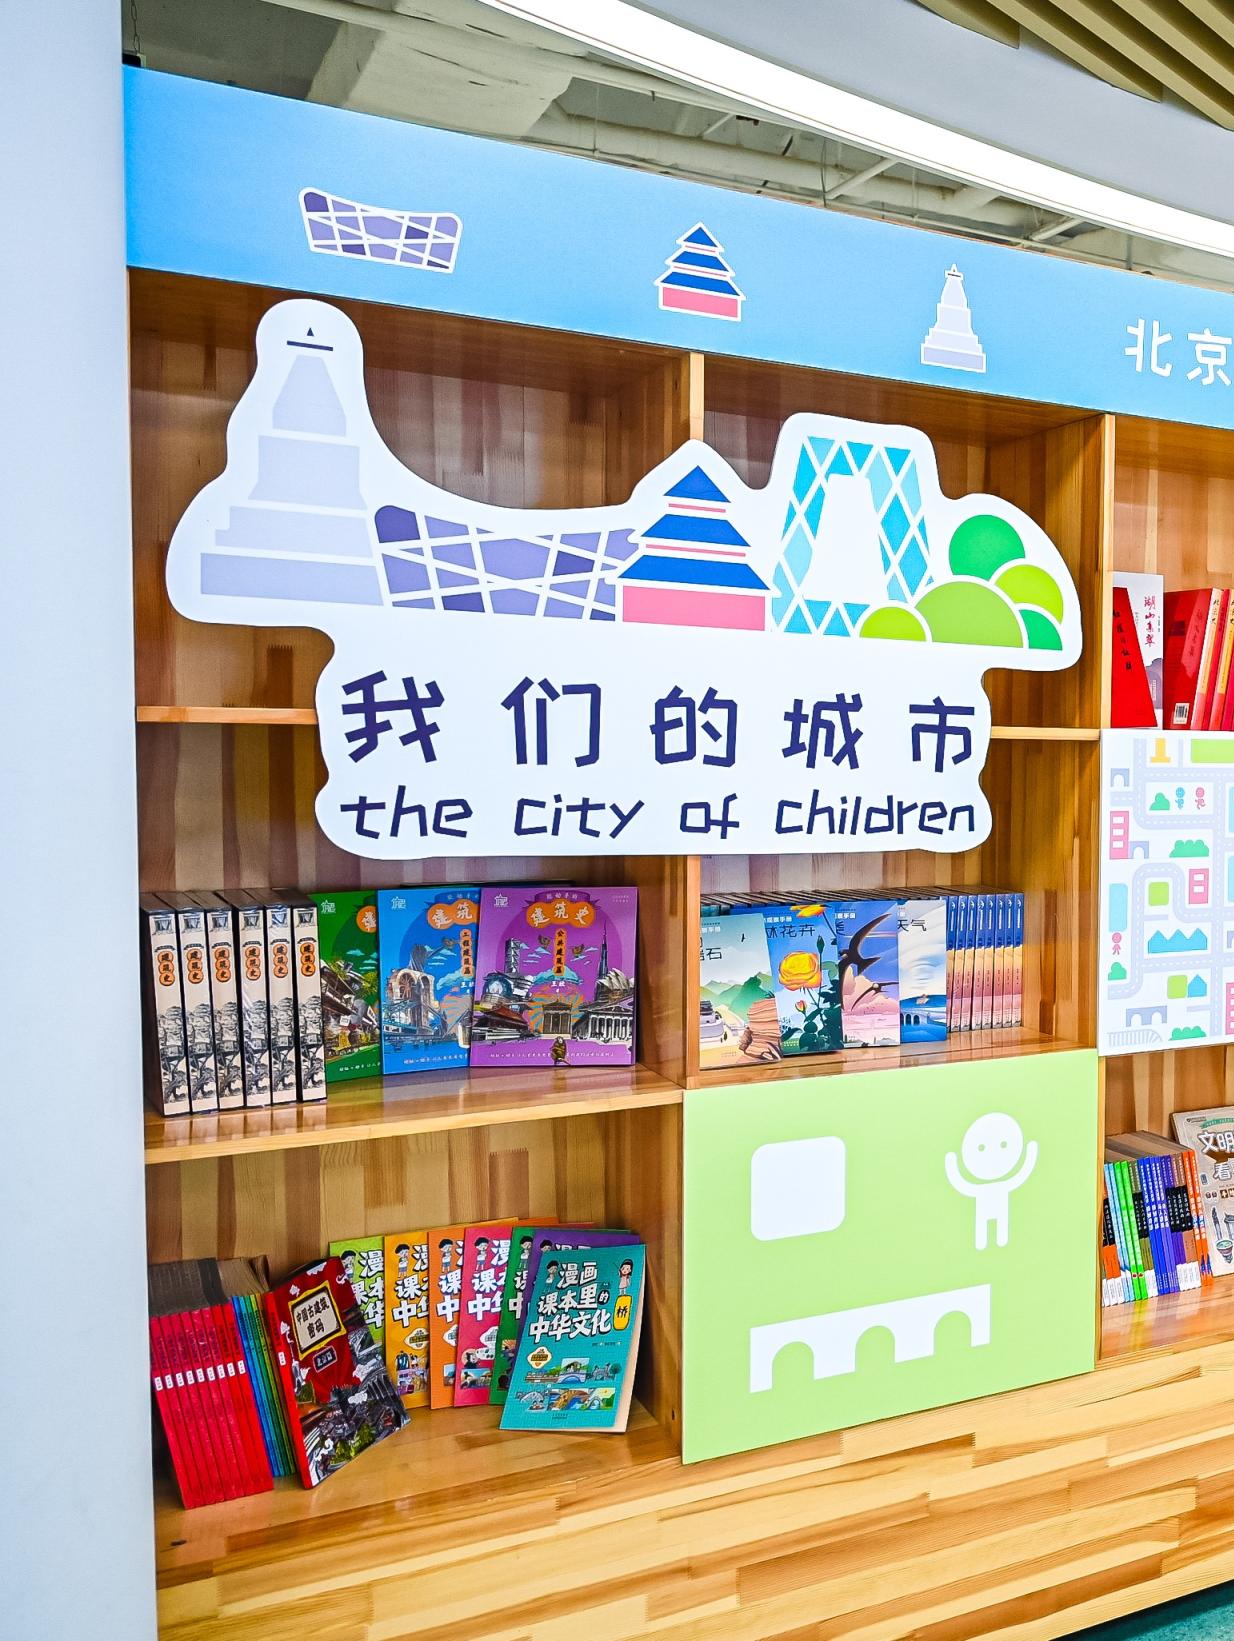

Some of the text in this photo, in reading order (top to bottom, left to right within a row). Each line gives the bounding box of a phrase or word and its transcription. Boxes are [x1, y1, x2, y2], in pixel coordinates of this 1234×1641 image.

[341, 670, 976, 774] 我们的城市
[340, 785, 976, 840] the city of children
[897, 919, 927, 932] 天气
[556, 1260, 598, 1290] 漫画
[295, 1296, 330, 1326] 中国古建筑
[436, 1294, 460, 1323] 中
[537, 1285, 610, 1316] 课本里的
[615, 1304, 629, 1320] 桥
[306, 1318, 325, 1339] 密码
[529, 1308, 613, 1344] 中华文化
